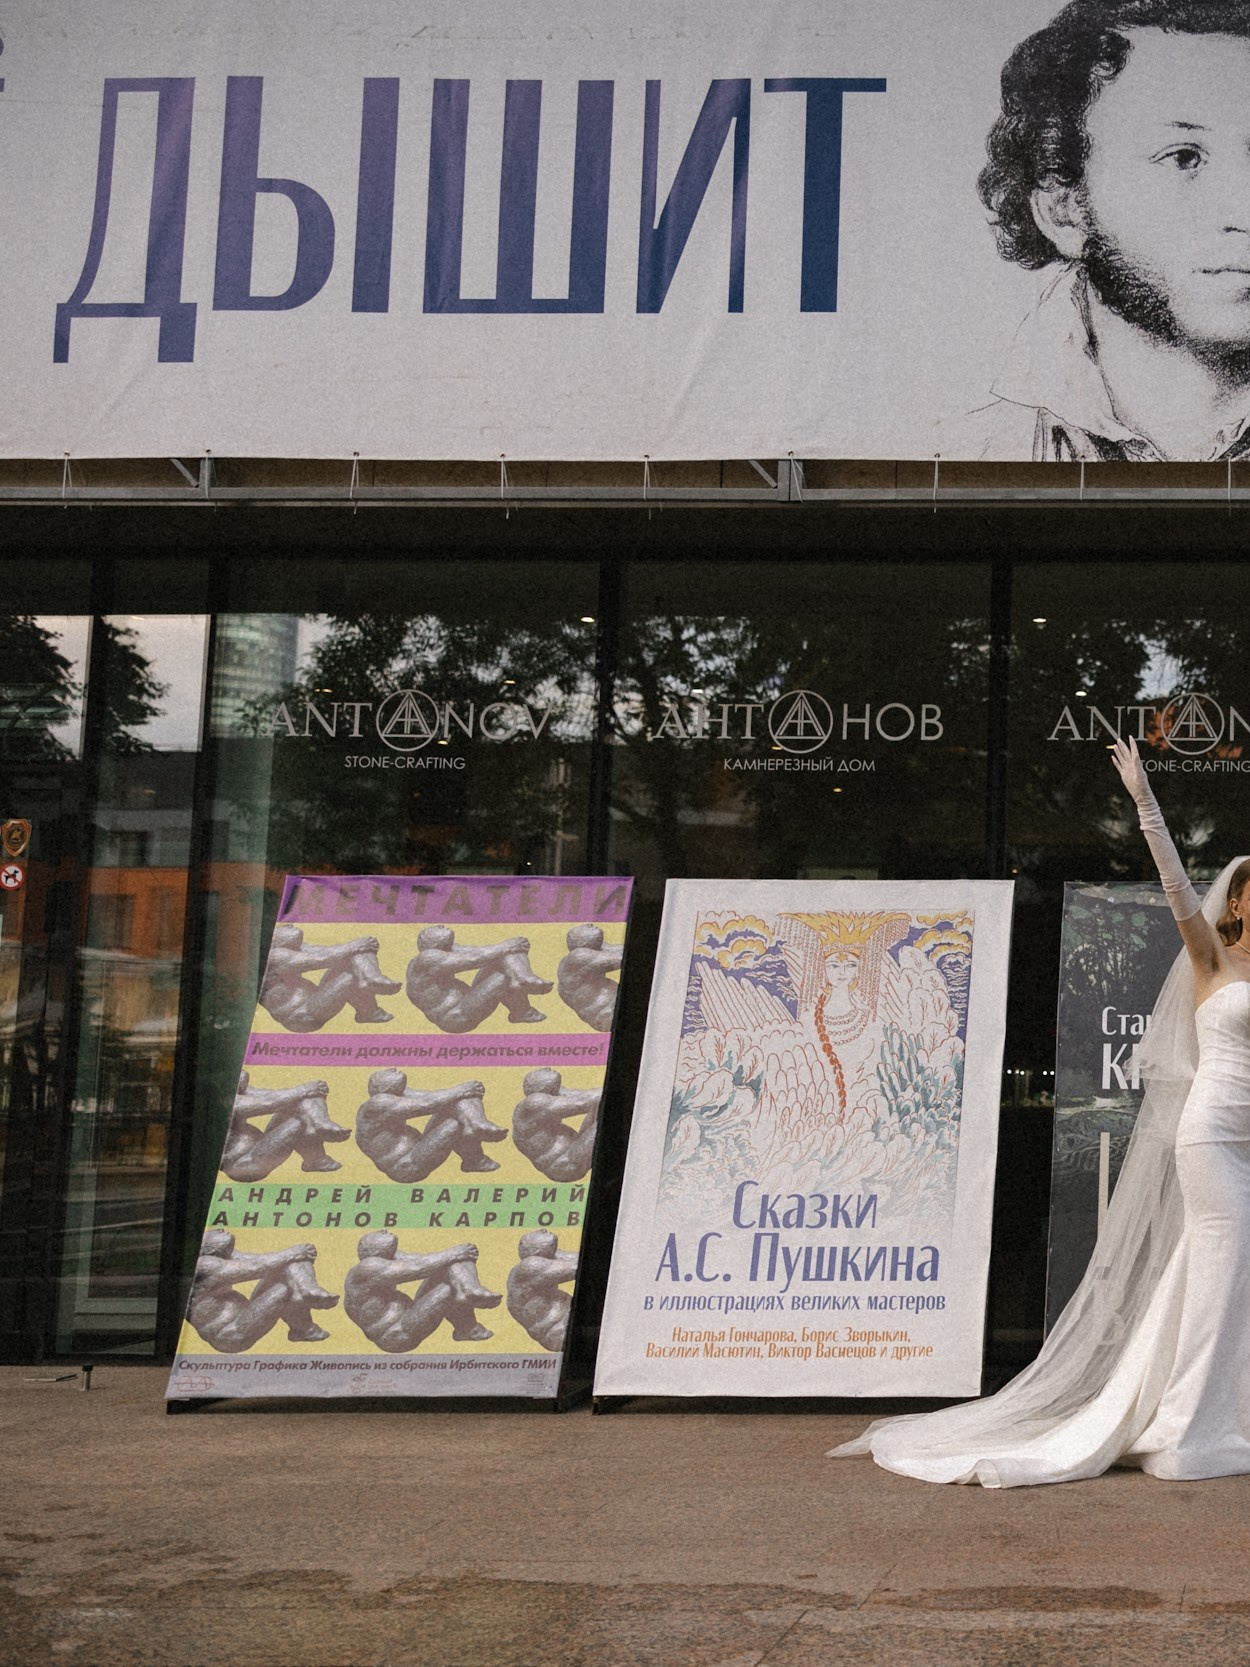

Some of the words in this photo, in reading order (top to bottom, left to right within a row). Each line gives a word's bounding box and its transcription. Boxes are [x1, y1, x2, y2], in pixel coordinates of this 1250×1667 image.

[53, 75, 887, 363] ДЫШИТ
[344, 755, 465, 770] STONE-CRAFTING
[724, 755, 833, 772] КАМНЕРЕЗНЫЙ
[837, 759, 875, 773] ДОМ
[283, 885, 628, 916] МЕЧТАТЕЛИ
[252, 1041, 354, 1058] Мечтатели
[356, 1041, 433, 1058] должны
[436, 1041, 534, 1059] держаться
[536, 1042, 606, 1056] вместе!
[218, 1184, 373, 1206] АНДРЕЙ
[410, 1184, 588, 1204] ВАЛЕРИЙ
[732, 1180, 878, 1230] Сказки
[212, 1211, 398, 1227] АНТОНОВ
[429, 1211, 581, 1227] КАРПОВ
[655, 1232, 732, 1282] А.С.
[749, 1232, 940, 1294] Пушкина
[644, 1295, 653, 1310] в
[659, 1294, 784, 1314] иллюстрациях
[791, 1294, 860, 1310] великих
[867, 1294, 946, 1314] мастеров
[672, 1327, 725, 1342] Наталья
[729, 1327, 797, 1345] Гончарова,
[801, 1327, 838, 1345] Борис
[844, 1327, 911, 1345] Зворыкин,
[646, 1343, 699, 1358] Василий
[703, 1343, 764, 1359] Масютин,
[767, 1343, 812, 1360] Виктор
[880, 1346, 888, 1358] и
[891, 1345, 933, 1360] другие
[179, 1360, 251, 1372] Скульптура
[253, 1360, 307, 1372] Графика
[310, 1360, 371, 1371] Живопись
[374, 1362, 387, 1370] из
[390, 1360, 447, 1371] собрания
[450, 1359, 519, 1371] Ирбитского
[521, 1359, 557, 1369] ГМИИ
